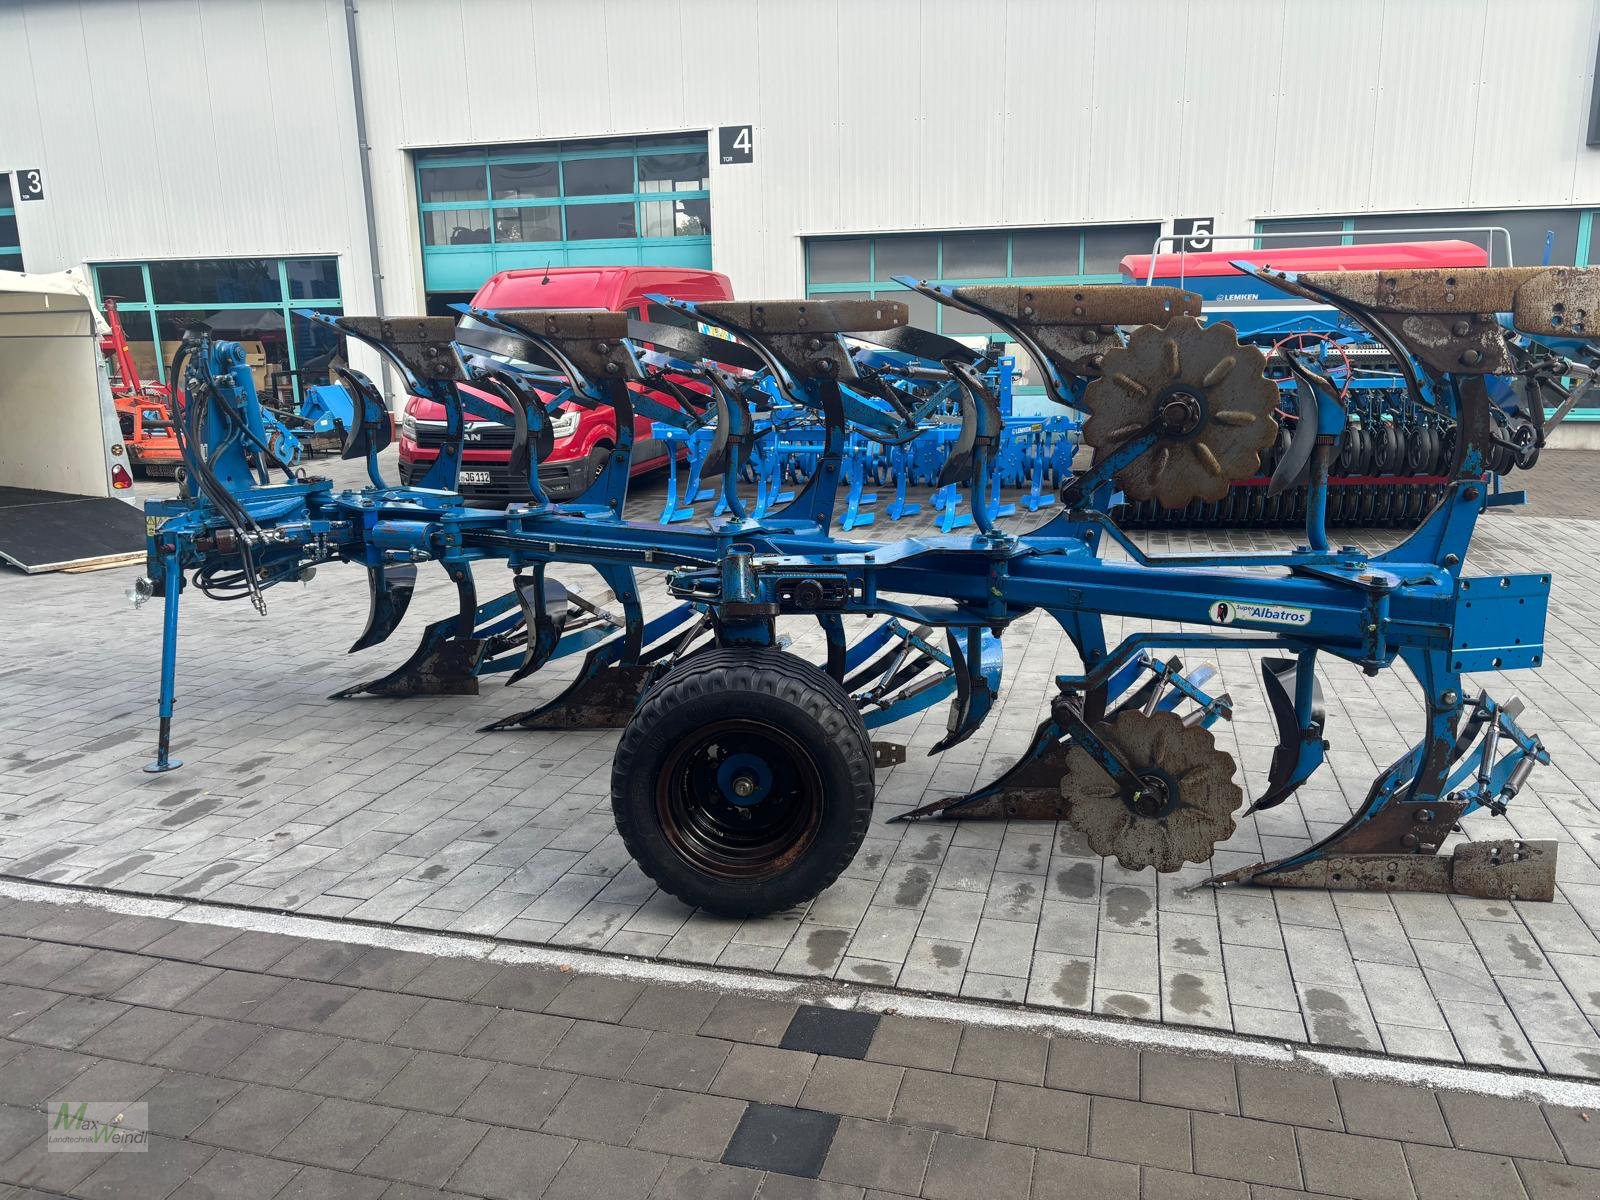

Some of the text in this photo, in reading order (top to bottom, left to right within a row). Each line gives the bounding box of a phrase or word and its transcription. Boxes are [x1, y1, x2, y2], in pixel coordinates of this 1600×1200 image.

[733, 128, 751, 153] 4
[28, 171, 41, 193] 3
[1190, 220, 1210, 248] 5
[463, 433, 481, 441] AN
[475, 472, 489, 482] 112
[1236, 604, 1305, 622] Super Albatros
